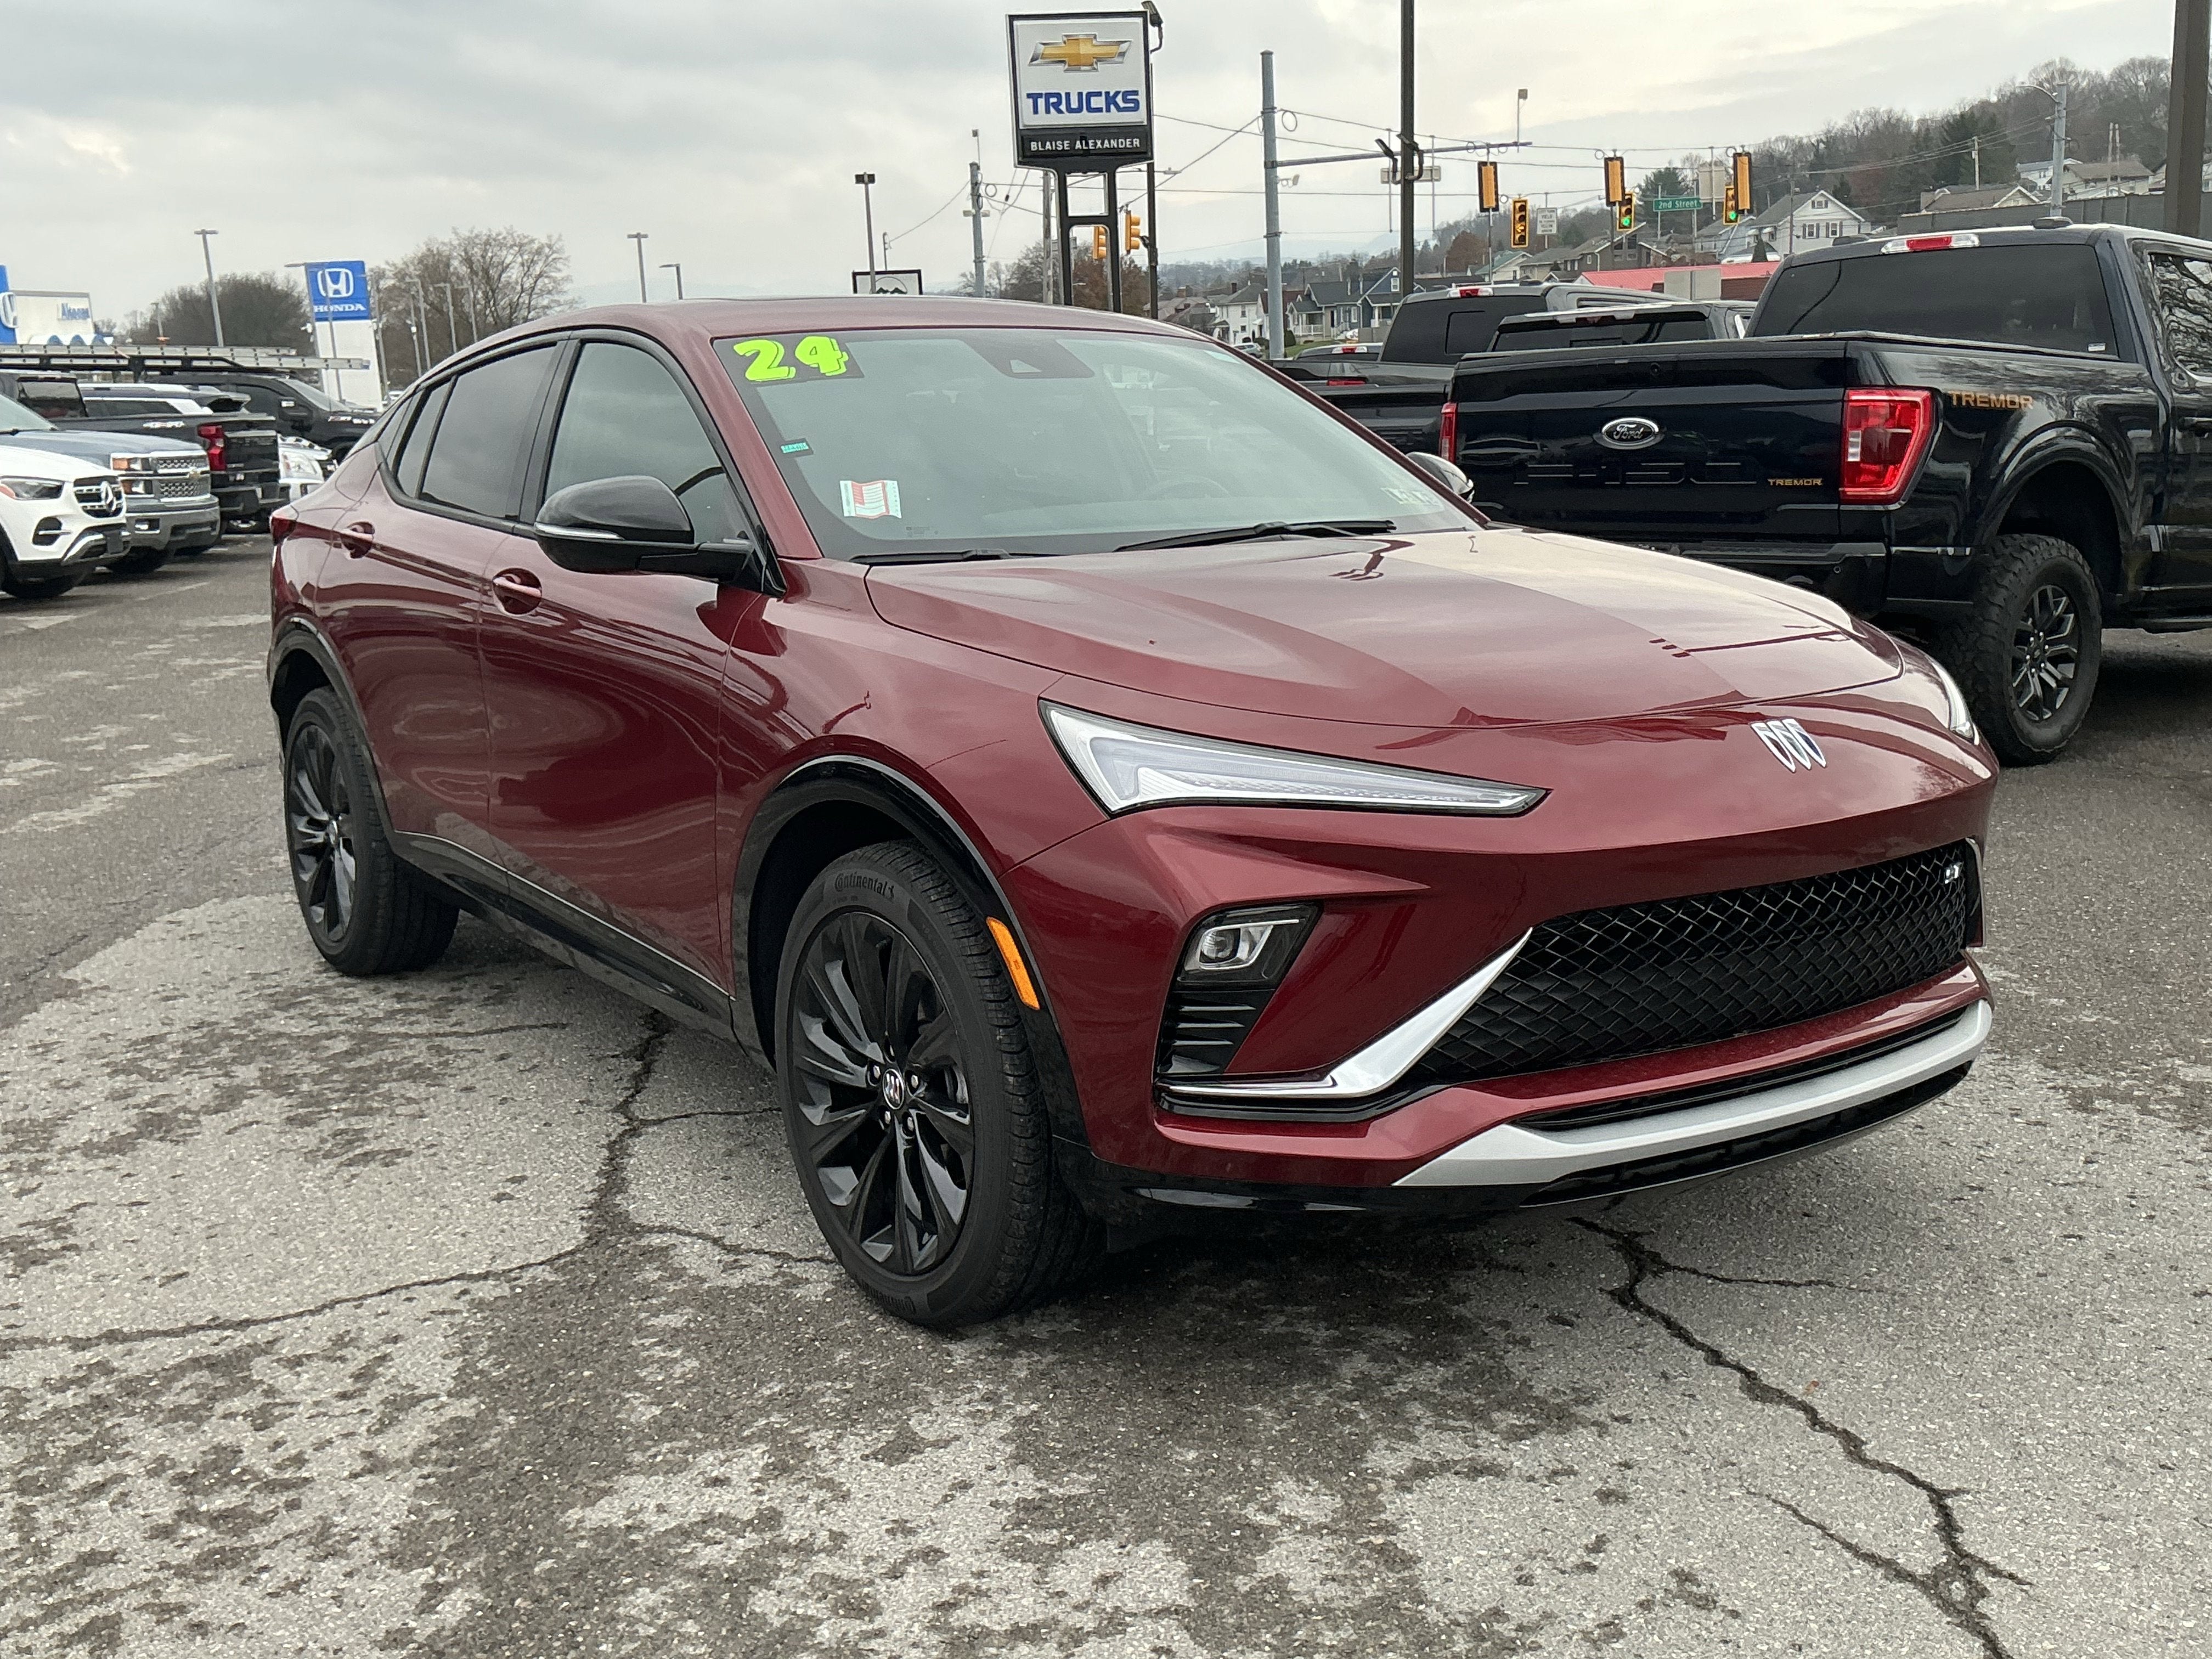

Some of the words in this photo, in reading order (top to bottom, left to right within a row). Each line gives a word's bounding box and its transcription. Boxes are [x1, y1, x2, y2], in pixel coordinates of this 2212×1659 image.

[1026, 89, 1140, 115] TRUCKS
[1031, 140, 1070, 151] BLAISE
[1075, 138, 1140, 150] ALEXANDER
[1658, 200, 1672, 209] 2nd
[1675, 200, 1698, 208] Street
[313, 303, 366, 312] HONDA
[733, 336, 849, 382] 24
[1948, 391, 2033, 409] TREMOR
[1613, 424, 1644, 439] Ford
[1767, 478, 1822, 486] TREMOR
[835, 871, 888, 896] Continental
